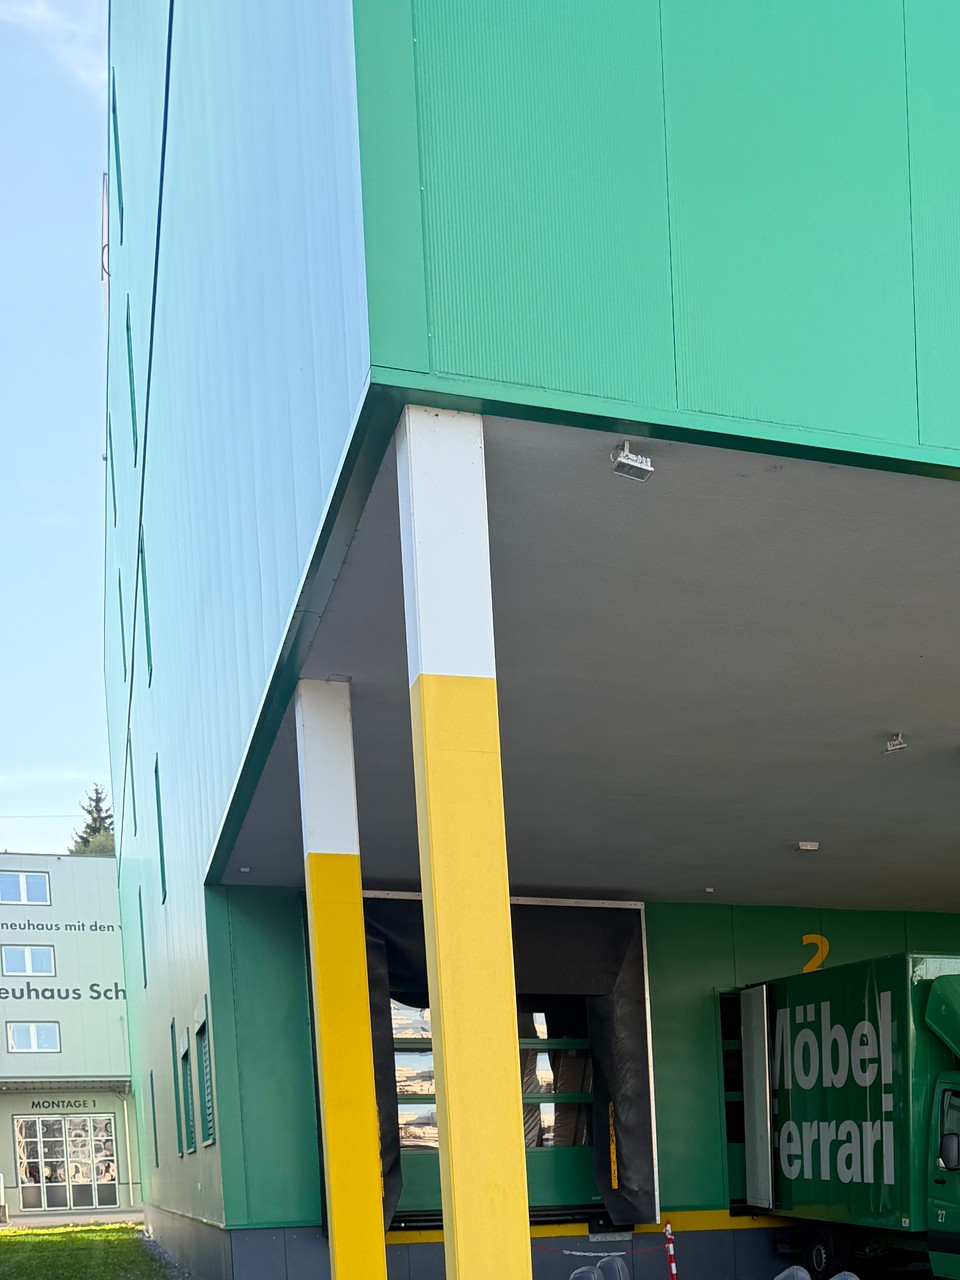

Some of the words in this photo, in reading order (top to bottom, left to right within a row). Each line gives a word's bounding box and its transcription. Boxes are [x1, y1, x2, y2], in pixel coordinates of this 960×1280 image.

[64, 921, 85, 931] mit
[89, 921, 114, 932] den
[802, 933, 830, 974] 2
[31, 1100, 88, 1109] MONTAGE
[92, 1099, 96, 1108] 1
[773, 1093, 895, 1185] errari
[937, 1210, 946, 1223] 27
